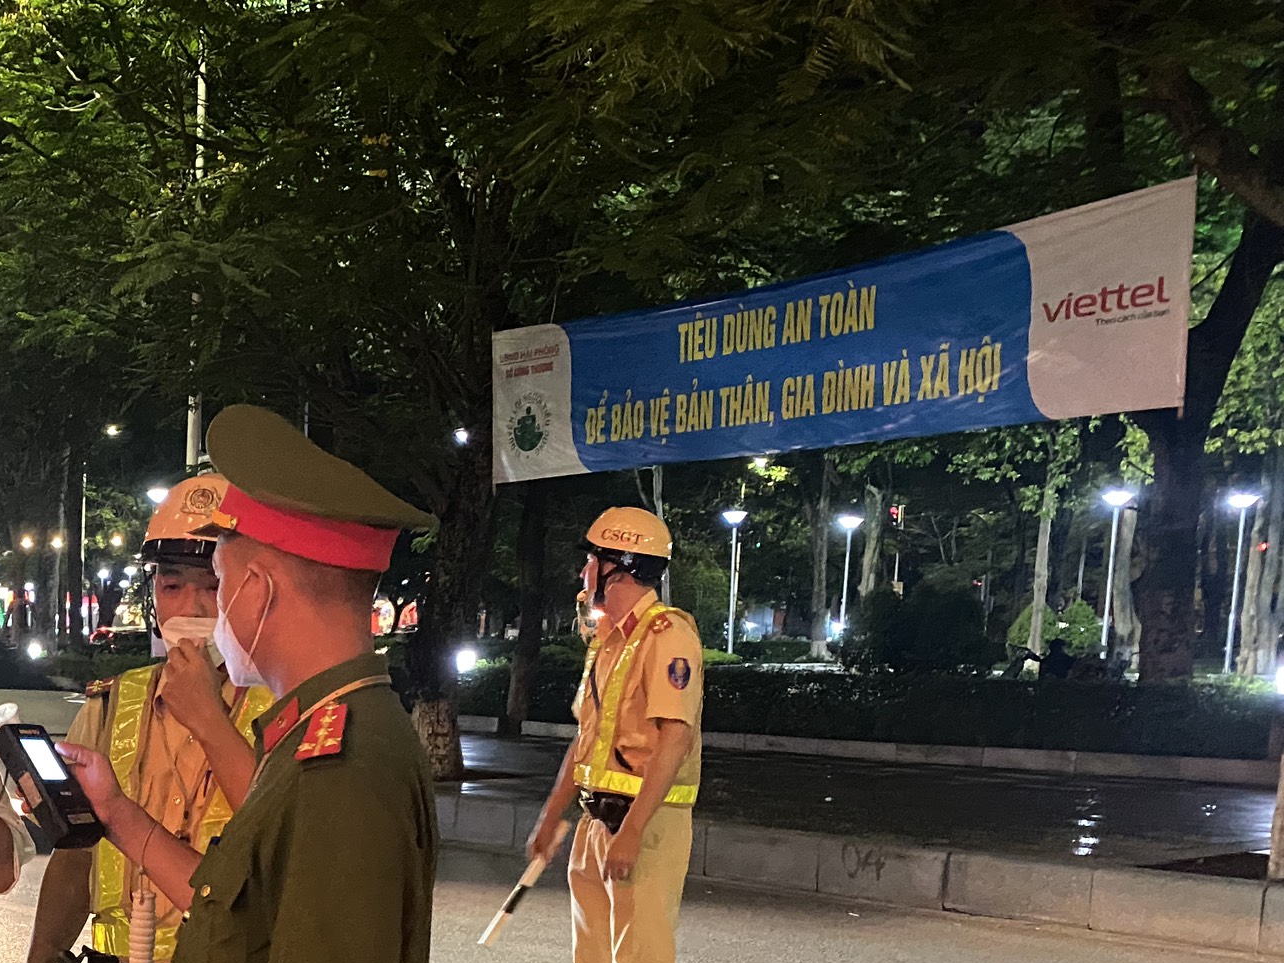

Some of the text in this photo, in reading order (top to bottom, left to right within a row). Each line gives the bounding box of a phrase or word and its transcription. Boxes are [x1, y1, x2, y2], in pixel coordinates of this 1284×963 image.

[678, 280, 877, 364] TIÊU DÙNG AN TOÀN
[1042, 276, 1170, 322] viettel
[585, 335, 1002, 445] ĐỂ BẢO VỆ BẢN THÂN, GIA ĐÌNH VÀ XÃ HỘI
[601, 528, 643, 545] CSGT
